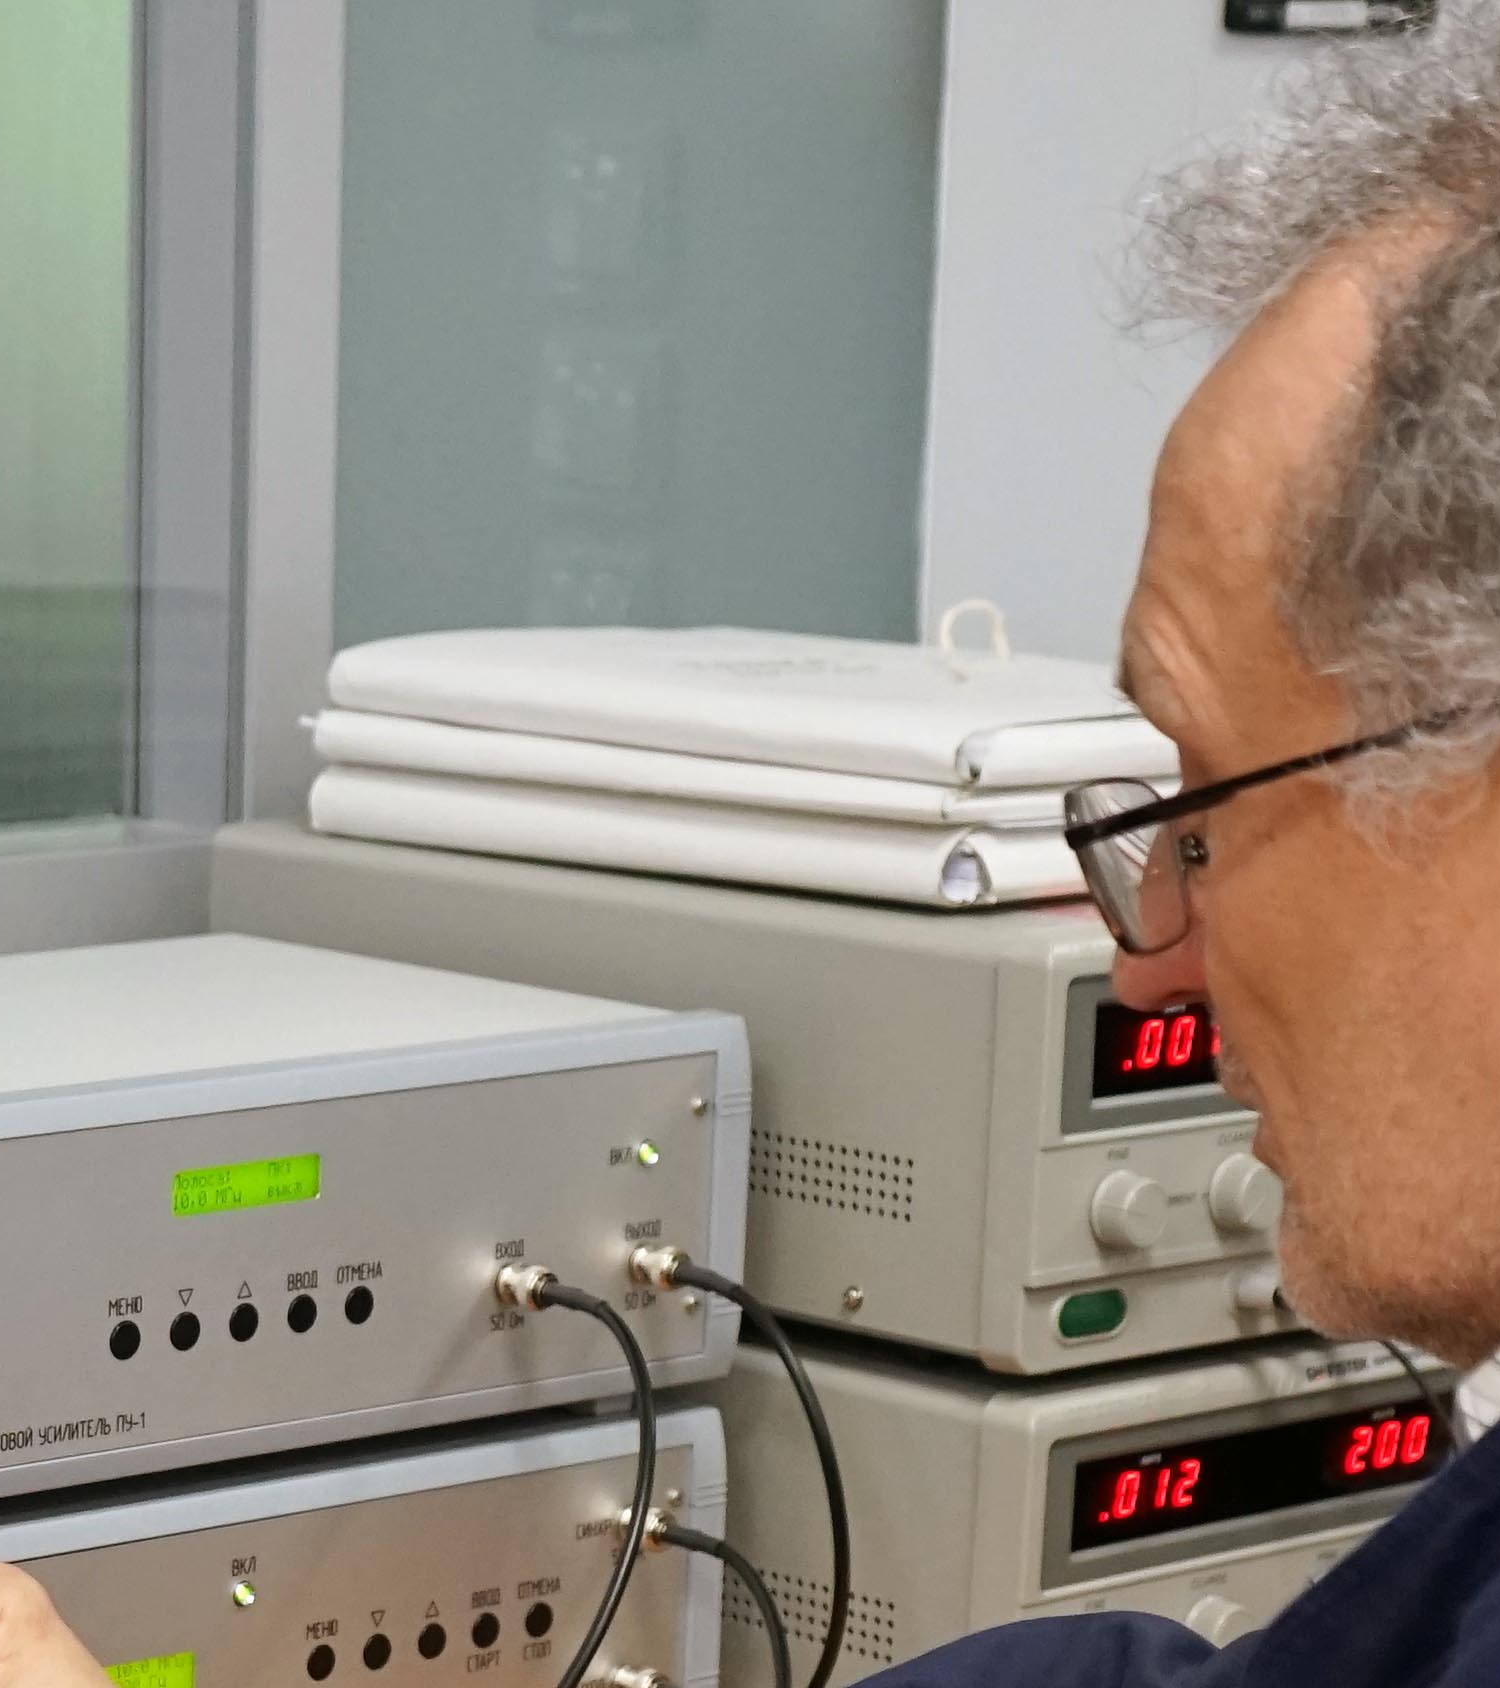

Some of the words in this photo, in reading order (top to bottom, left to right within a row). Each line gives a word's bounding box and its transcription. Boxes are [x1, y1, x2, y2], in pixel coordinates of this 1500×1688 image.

[1121, 1015, 1221, 1072] .00
[609, 1147, 633, 1166] ВКЛ
[625, 1219, 662, 1241] ВЫХОД
[495, 1239, 525, 1260] ВХОД
[287, 1270, 318, 1292] ВВОД
[336, 1261, 383, 1285] ОТМЕНА
[108, 1296, 143, 1318] МЕНЮ
[625, 1293, 641, 1311] 50
[490, 1312, 505, 1331] 50
[38, 1416, 112, 1447] УСИЛИТЕЛЬ
[116, 1411, 147, 1436] ПУ-1
[1344, 1415, 1431, 1474] 200
[1097, 1458, 1201, 1523] .012
[231, 1555, 258, 1577] ВКЛ
[471, 1587, 501, 1608] ВВОД
[516, 1576, 561, 1600] ОТМЕНА
[306, 1618, 339, 1641] МЕНЮ
[466, 1649, 501, 1673] СТАРТ
[522, 1640, 552, 1661] СТОП
